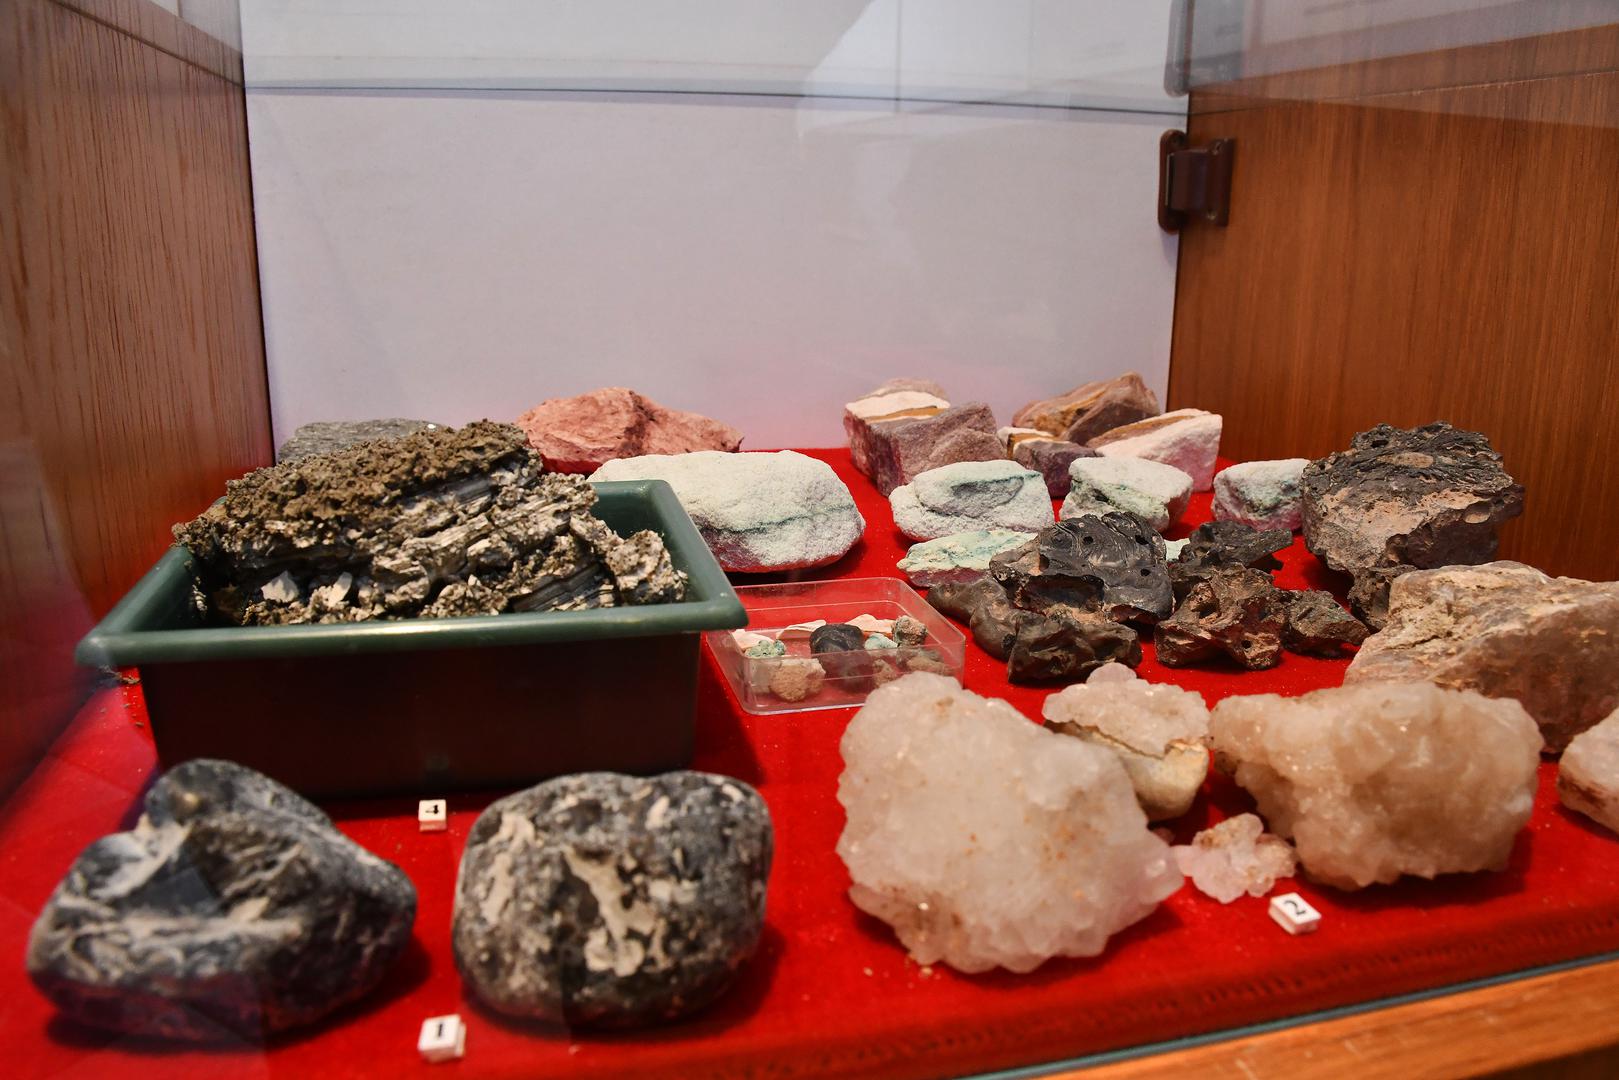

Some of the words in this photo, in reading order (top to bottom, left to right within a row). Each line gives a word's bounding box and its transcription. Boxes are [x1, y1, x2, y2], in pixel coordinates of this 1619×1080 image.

[424, 804, 440, 815] 4
[1283, 900, 1307, 916] 2
[434, 1021, 446, 1039] 1
